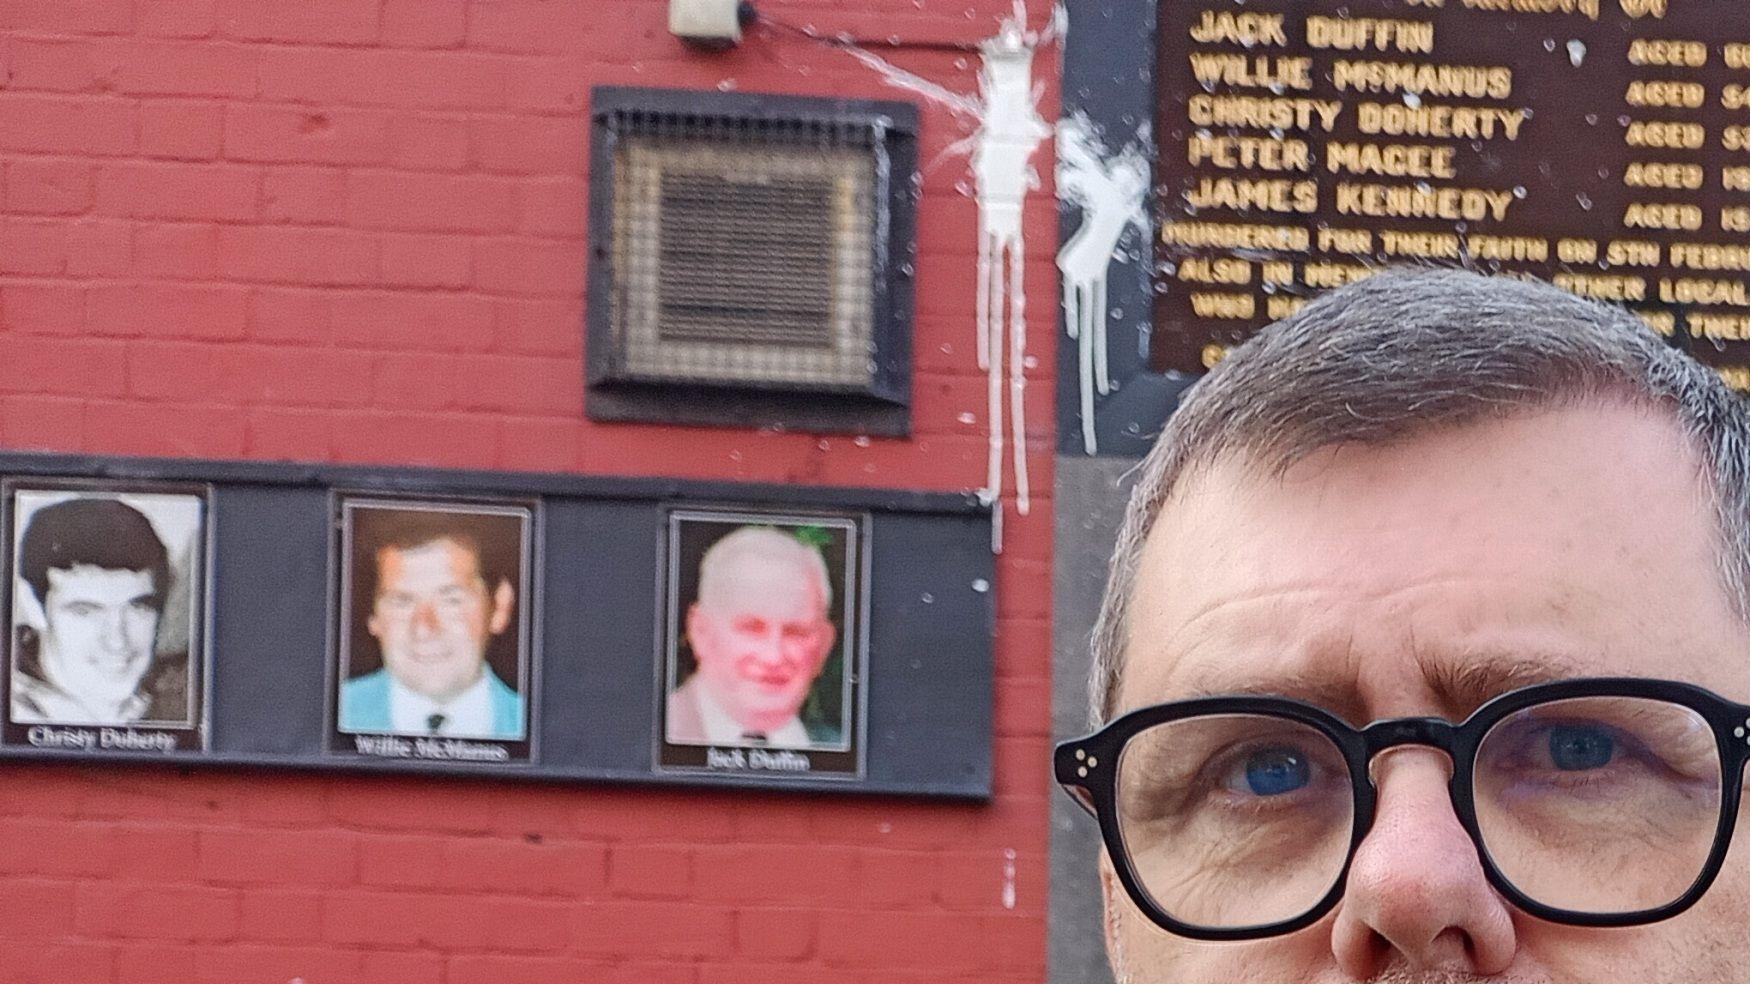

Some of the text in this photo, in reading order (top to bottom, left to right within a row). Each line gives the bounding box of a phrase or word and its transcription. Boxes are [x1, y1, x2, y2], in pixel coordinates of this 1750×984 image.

[1189, 9, 1288, 46] JACK
[1306, 15, 1434, 53] DUFFIN
[1627, 39, 1707, 67] AGED
[1189, 52, 1313, 90] WILLIE
[1625, 80, 1705, 109] AGED
[1188, 94, 1342, 132] CHRISTY
[1358, 101, 1525, 141] DOHERTY
[1625, 121, 1705, 149] AGED
[1188, 136, 1309, 172] PETER
[1326, 140, 1457, 179] MAGEE
[1623, 162, 1703, 190] AGED
[1189, 176, 1318, 213] JAMES
[1336, 181, 1514, 222] KENNEDY
[1623, 202, 1703, 231] AGED
[1177, 258, 1251, 285] ALSO
[1262, 261, 1293, 286] IN
[1317, 227, 1372, 252] FOR
[1380, 229, 1459, 259] THEIR
[1467, 234, 1548, 262] FAITH
[1557, 237, 1597, 264] ON
[1190, 292, 1255, 320] WHO
